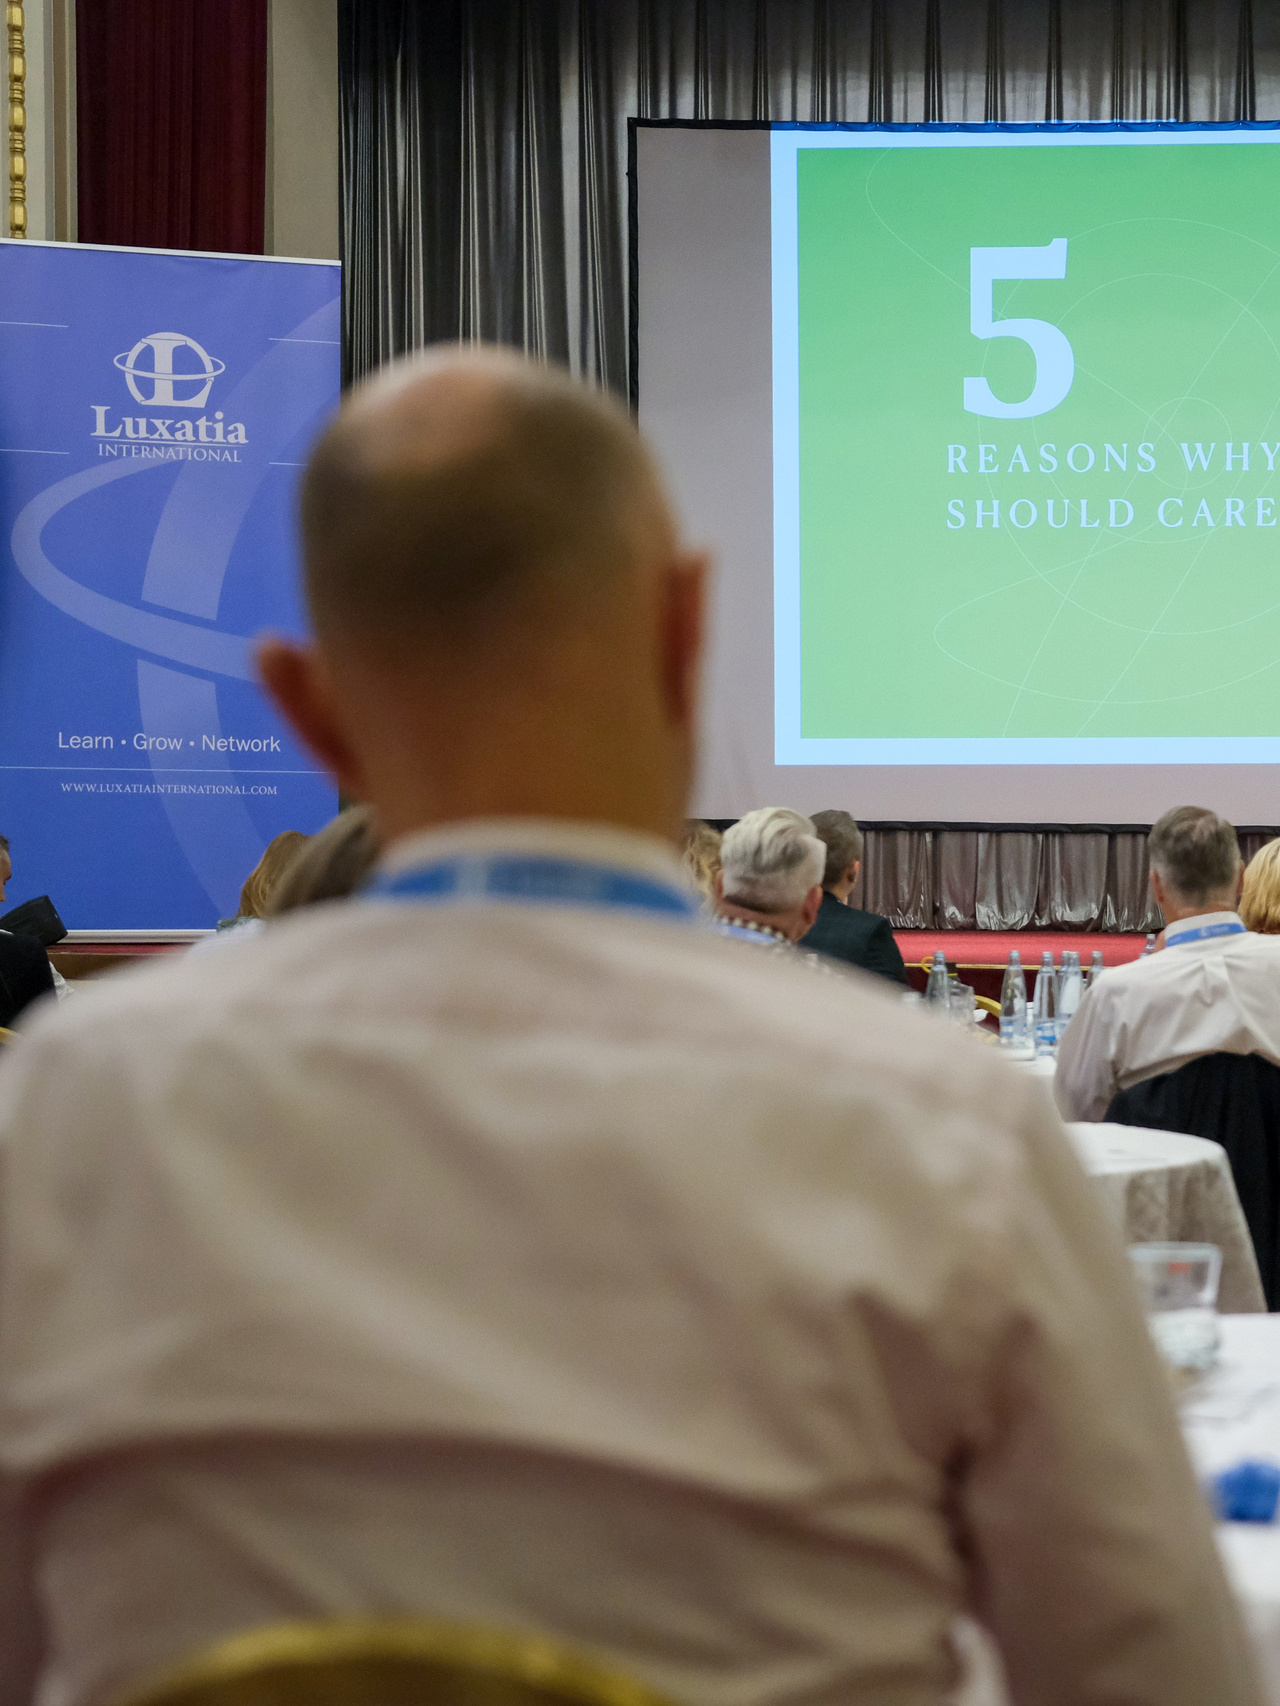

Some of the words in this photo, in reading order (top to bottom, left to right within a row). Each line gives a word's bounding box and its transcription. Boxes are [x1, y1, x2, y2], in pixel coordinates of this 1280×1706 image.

[964, 238, 1075, 419] 5
[90, 405, 249, 444] Luxatia
[98, 443, 241, 463] INTERNATIONAL
[947, 442, 1156, 473] REASONS
[946, 499, 1135, 529] SHOULD
[1157, 497, 1277, 528] CARE
[58, 732, 114, 749] Learn
[133, 733, 183, 751] Grow
[202, 735, 281, 752] Network
[61, 783, 278, 795] WWW.LUXATIAINTERNATIONAL.COM
